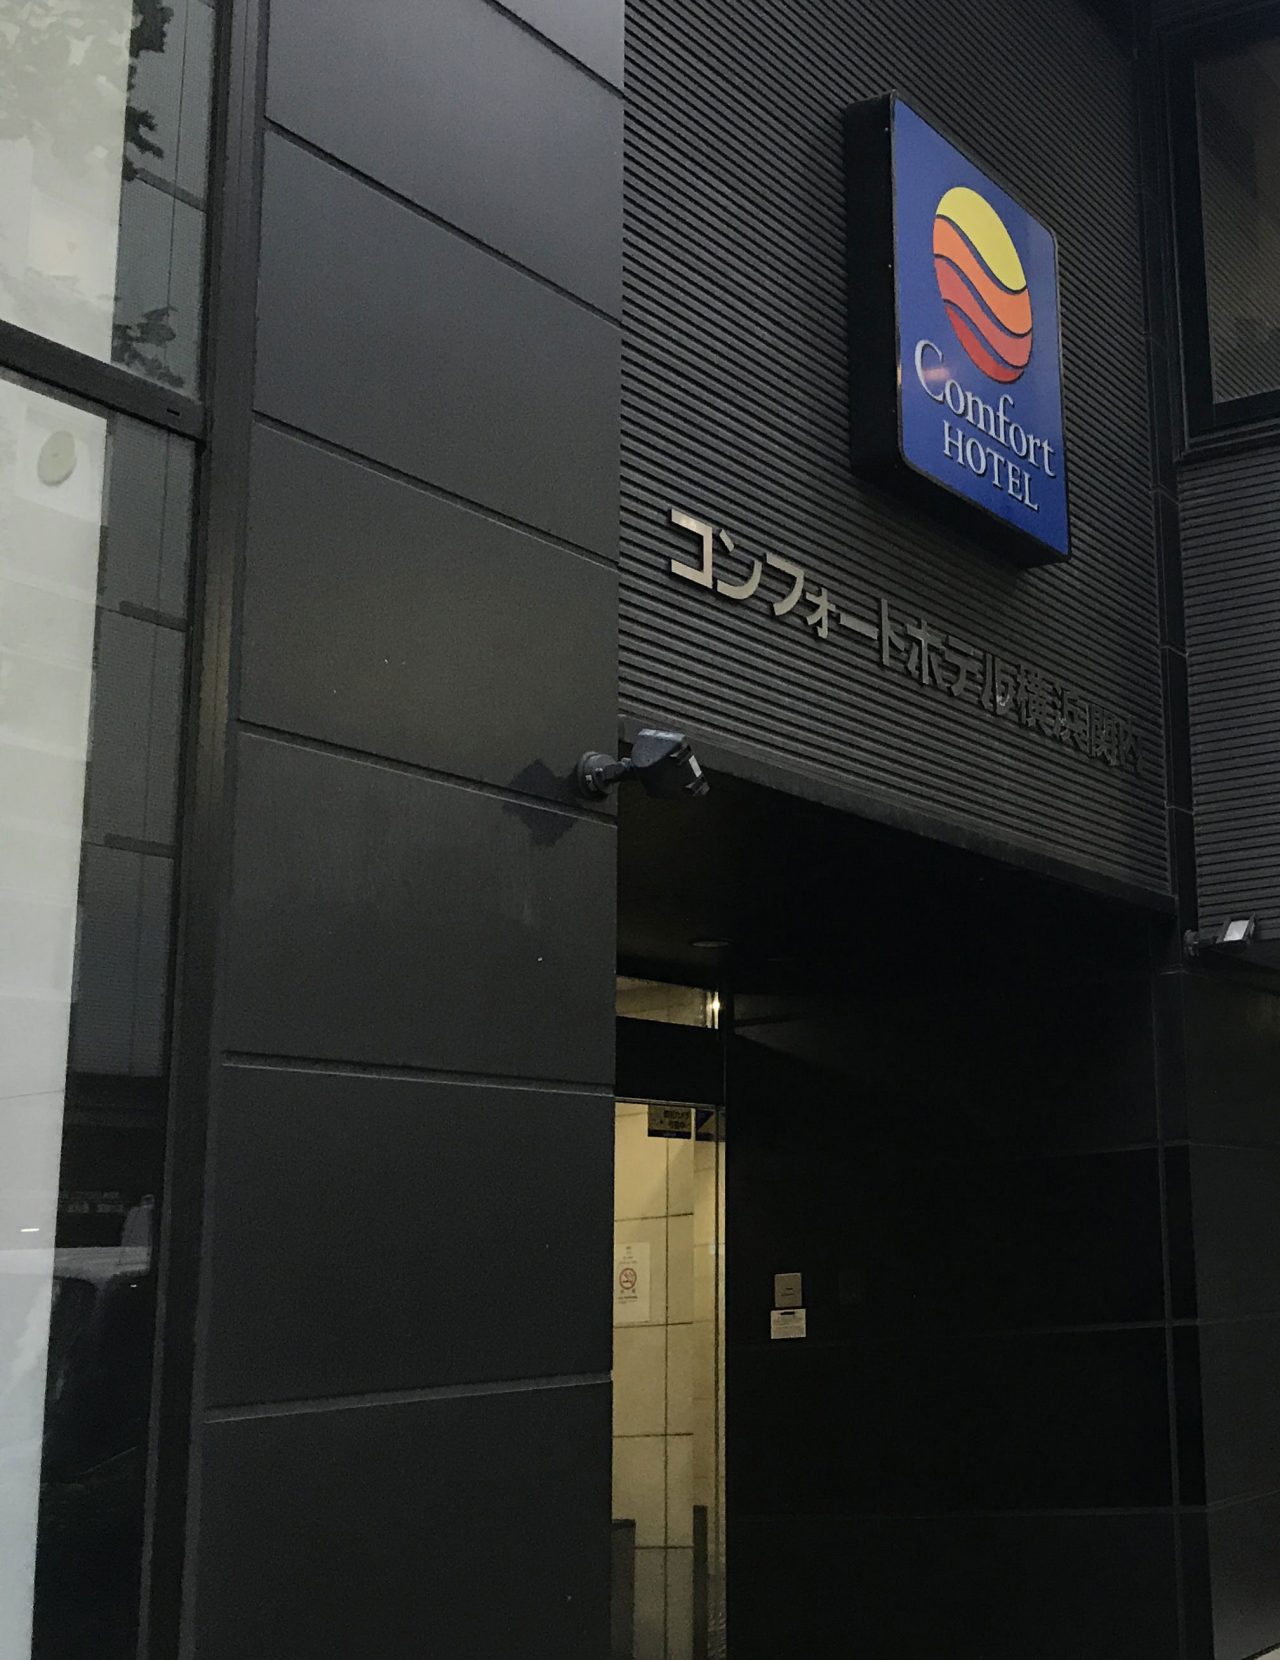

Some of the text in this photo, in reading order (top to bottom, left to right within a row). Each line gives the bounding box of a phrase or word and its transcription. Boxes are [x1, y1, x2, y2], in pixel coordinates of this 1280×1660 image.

[914, 339, 1056, 478] Comfort
[942, 419, 1039, 512] HOTEL
[670, 508, 1142, 773] コンフォートホテル横浜関内
